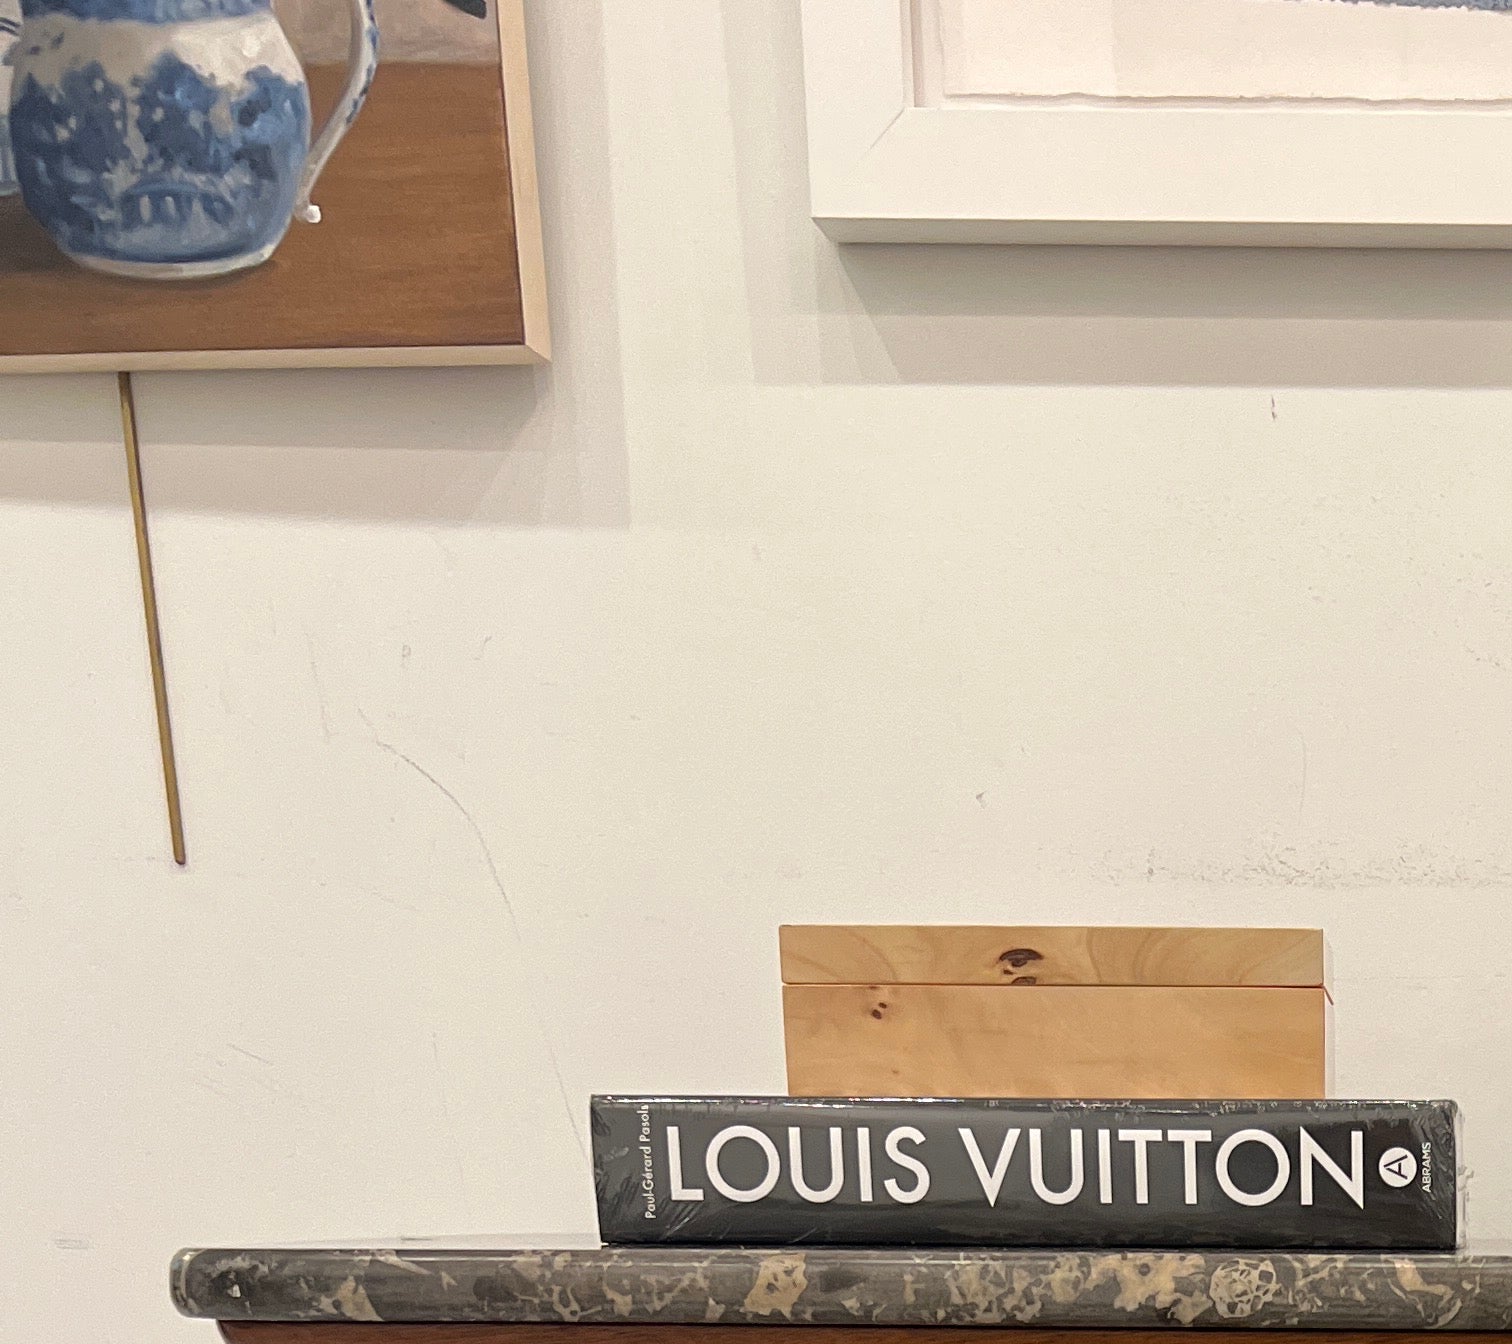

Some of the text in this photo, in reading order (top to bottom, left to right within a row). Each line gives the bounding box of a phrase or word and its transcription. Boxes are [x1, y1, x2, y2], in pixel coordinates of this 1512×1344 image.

[636, 1104, 657, 1219] Paul-Gérard Pasols
[666, 1125, 1364, 1210] LOUIS VUITTON
[1383, 1154, 1408, 1180] A
[1421, 1142, 1432, 1193] ABRAMS
